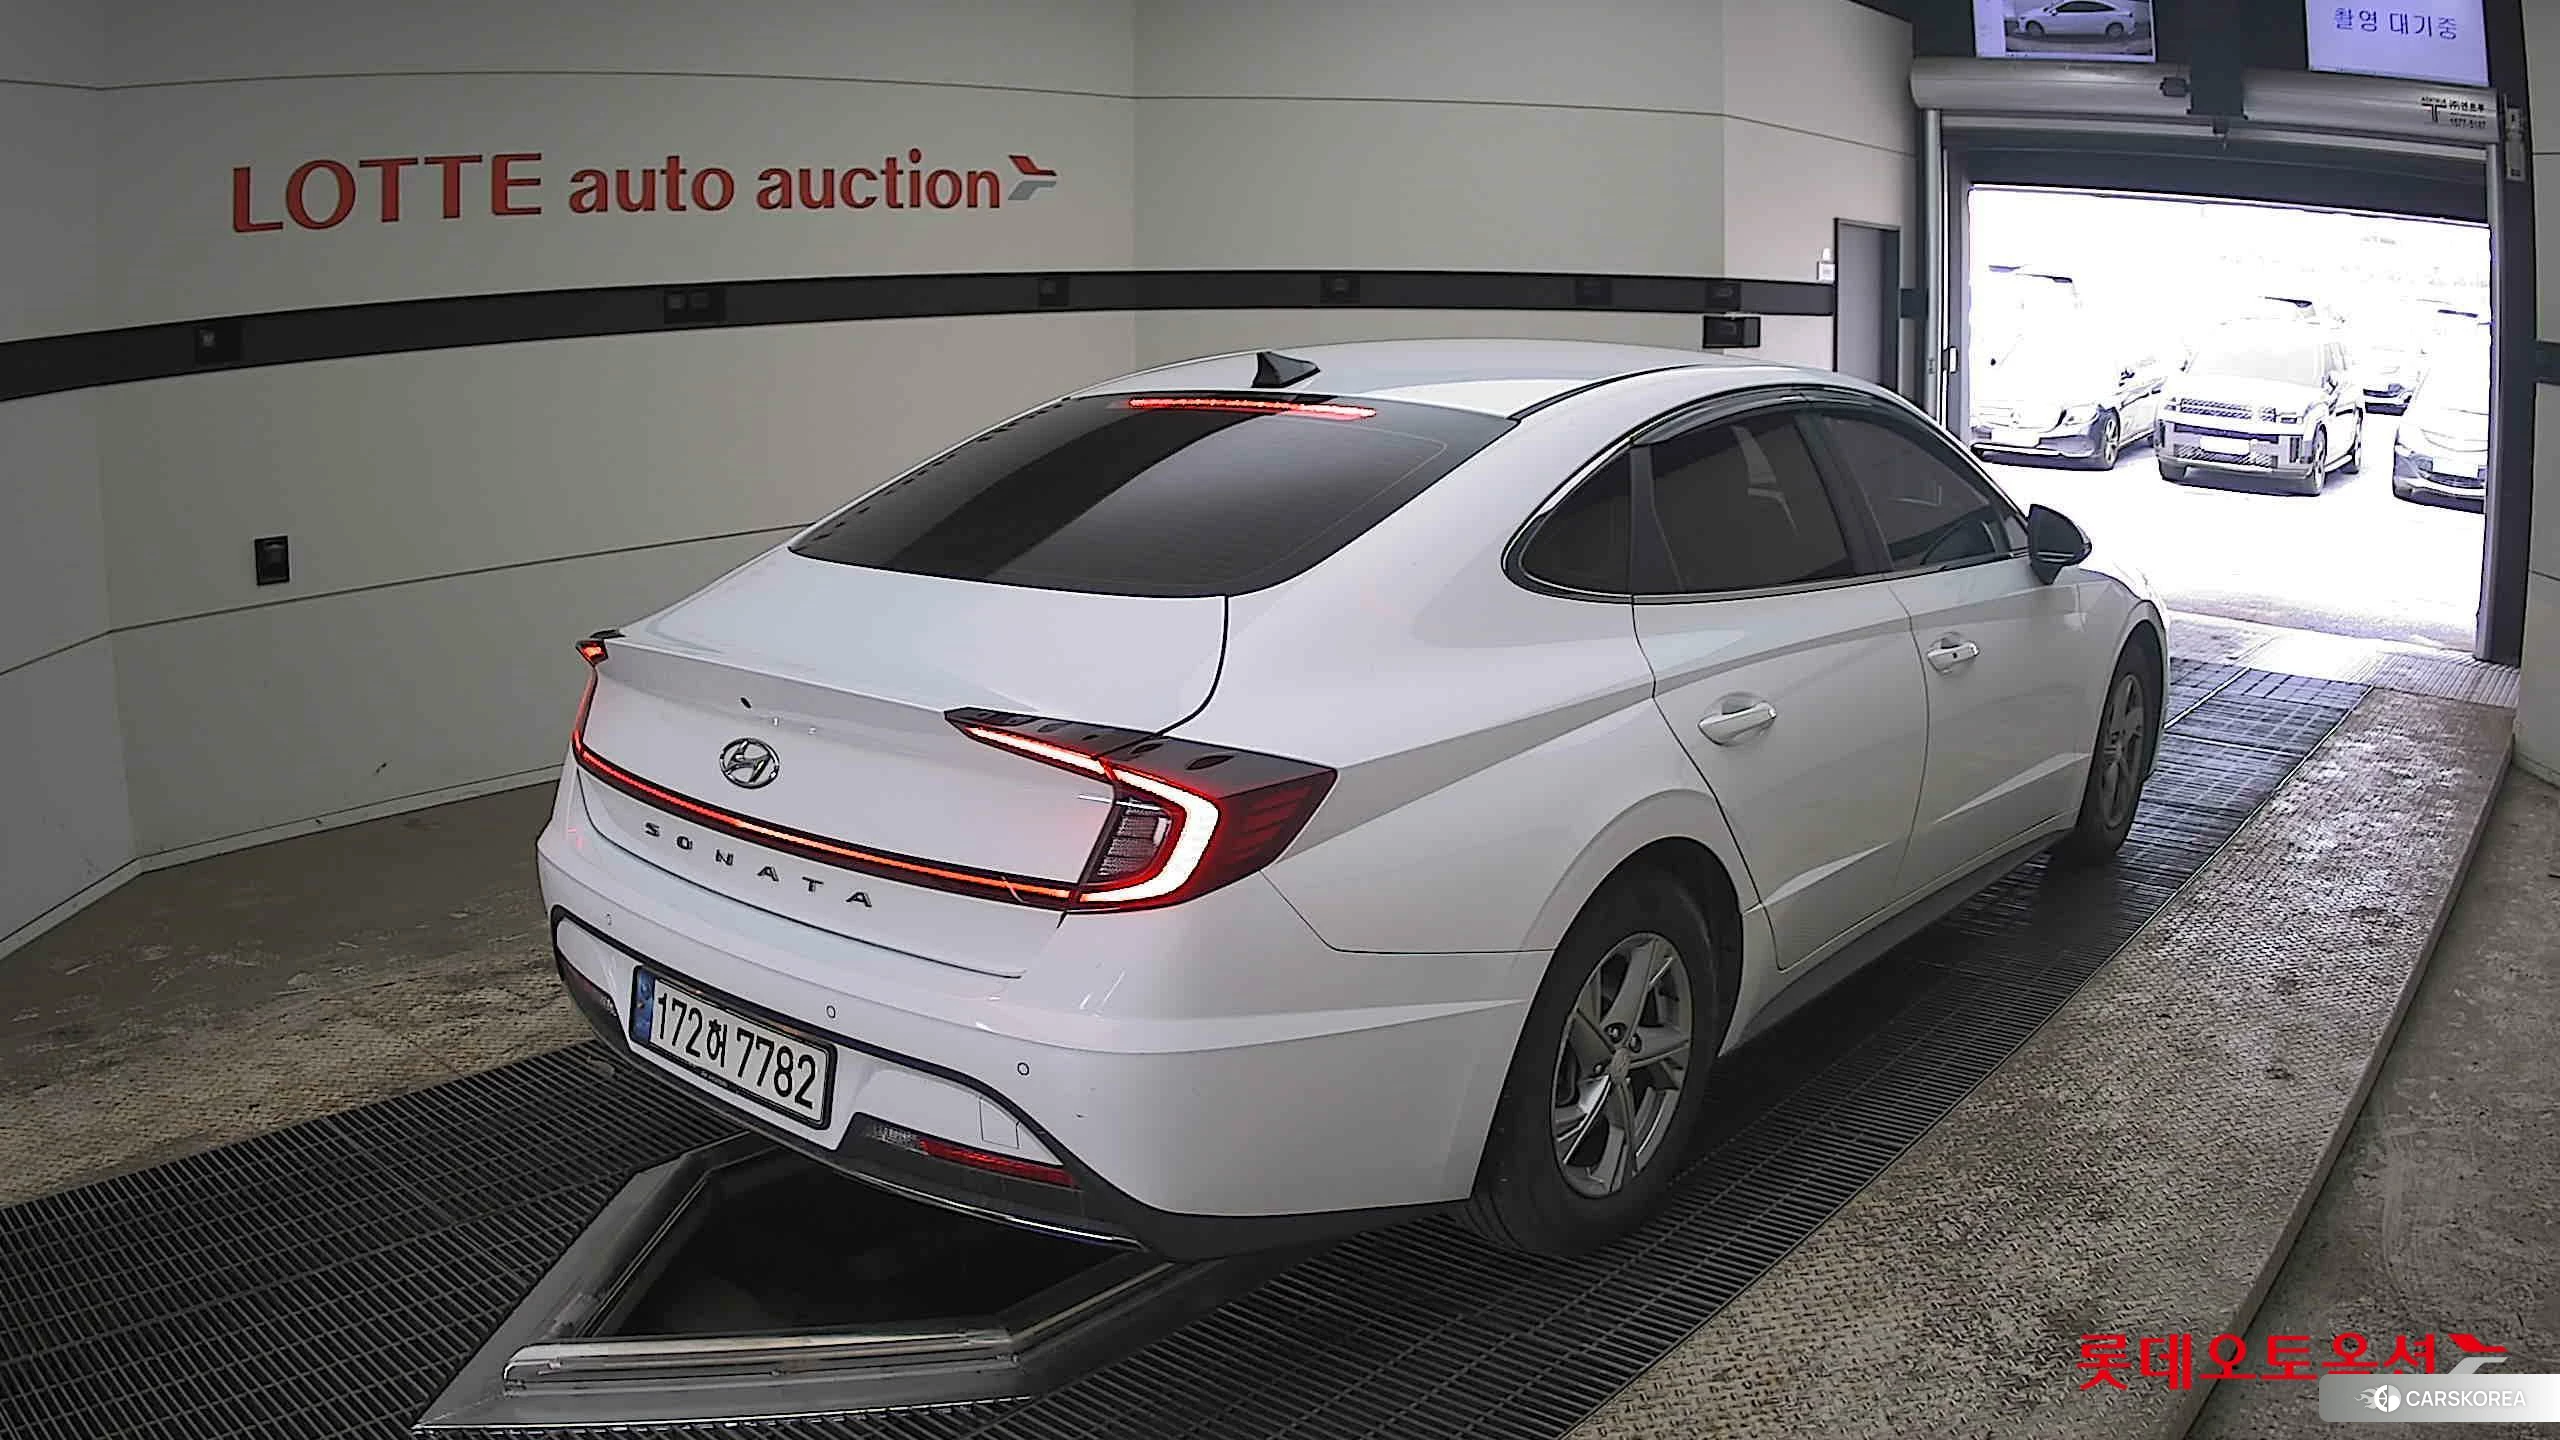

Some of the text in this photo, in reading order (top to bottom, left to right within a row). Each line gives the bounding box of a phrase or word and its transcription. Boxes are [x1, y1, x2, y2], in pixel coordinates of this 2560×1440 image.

[2389, 12, 2457, 40] 대기중
[232, 148, 1001, 233] LOTTE auto auction
[645, 822, 873, 908] SONATA
